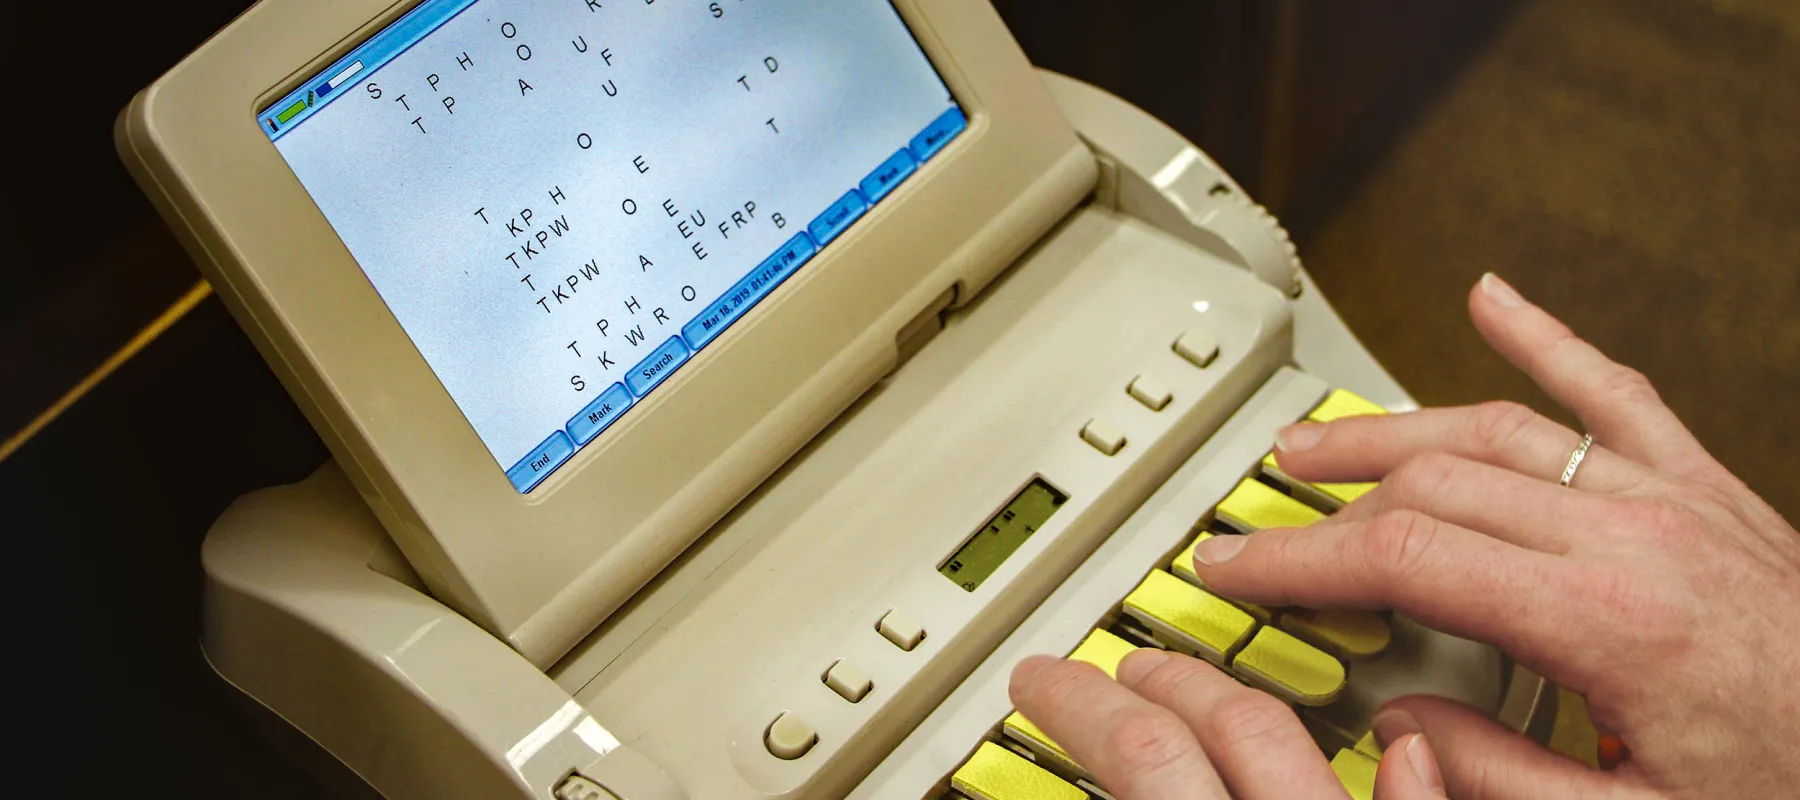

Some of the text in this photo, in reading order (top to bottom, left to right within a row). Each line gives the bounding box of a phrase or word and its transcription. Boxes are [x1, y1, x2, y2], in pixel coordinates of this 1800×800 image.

[366, 82, 383, 100] S
[394, 21, 517, 112] T P H O
[410, 116, 427, 135] T
[441, 96, 456, 115] P
[515, 43, 532, 62] O
[517, 35, 588, 97] A U
[600, 47, 613, 67] F
[601, 2, 724, 98] U S
[473, 132, 593, 225] T O
[505, 56, 779, 269] TKPW E T D
[506, 185, 567, 237] KP H
[520, 198, 638, 292] T O
[536, 117, 779, 313] TKPW E T
[638, 210, 705, 273] A EU
[566, 201, 755, 358] T P H E FRP
[570, 211, 787, 393] S K W R O B
[702, 315, 720, 331] Mar
[719, 305, 734, 317] 18,
[731, 288, 750, 308] 2019
[781, 250, 796, 266] PM
[642, 353, 674, 380] Search
[588, 403, 613, 425] Mark
[530, 453, 550, 473] End
